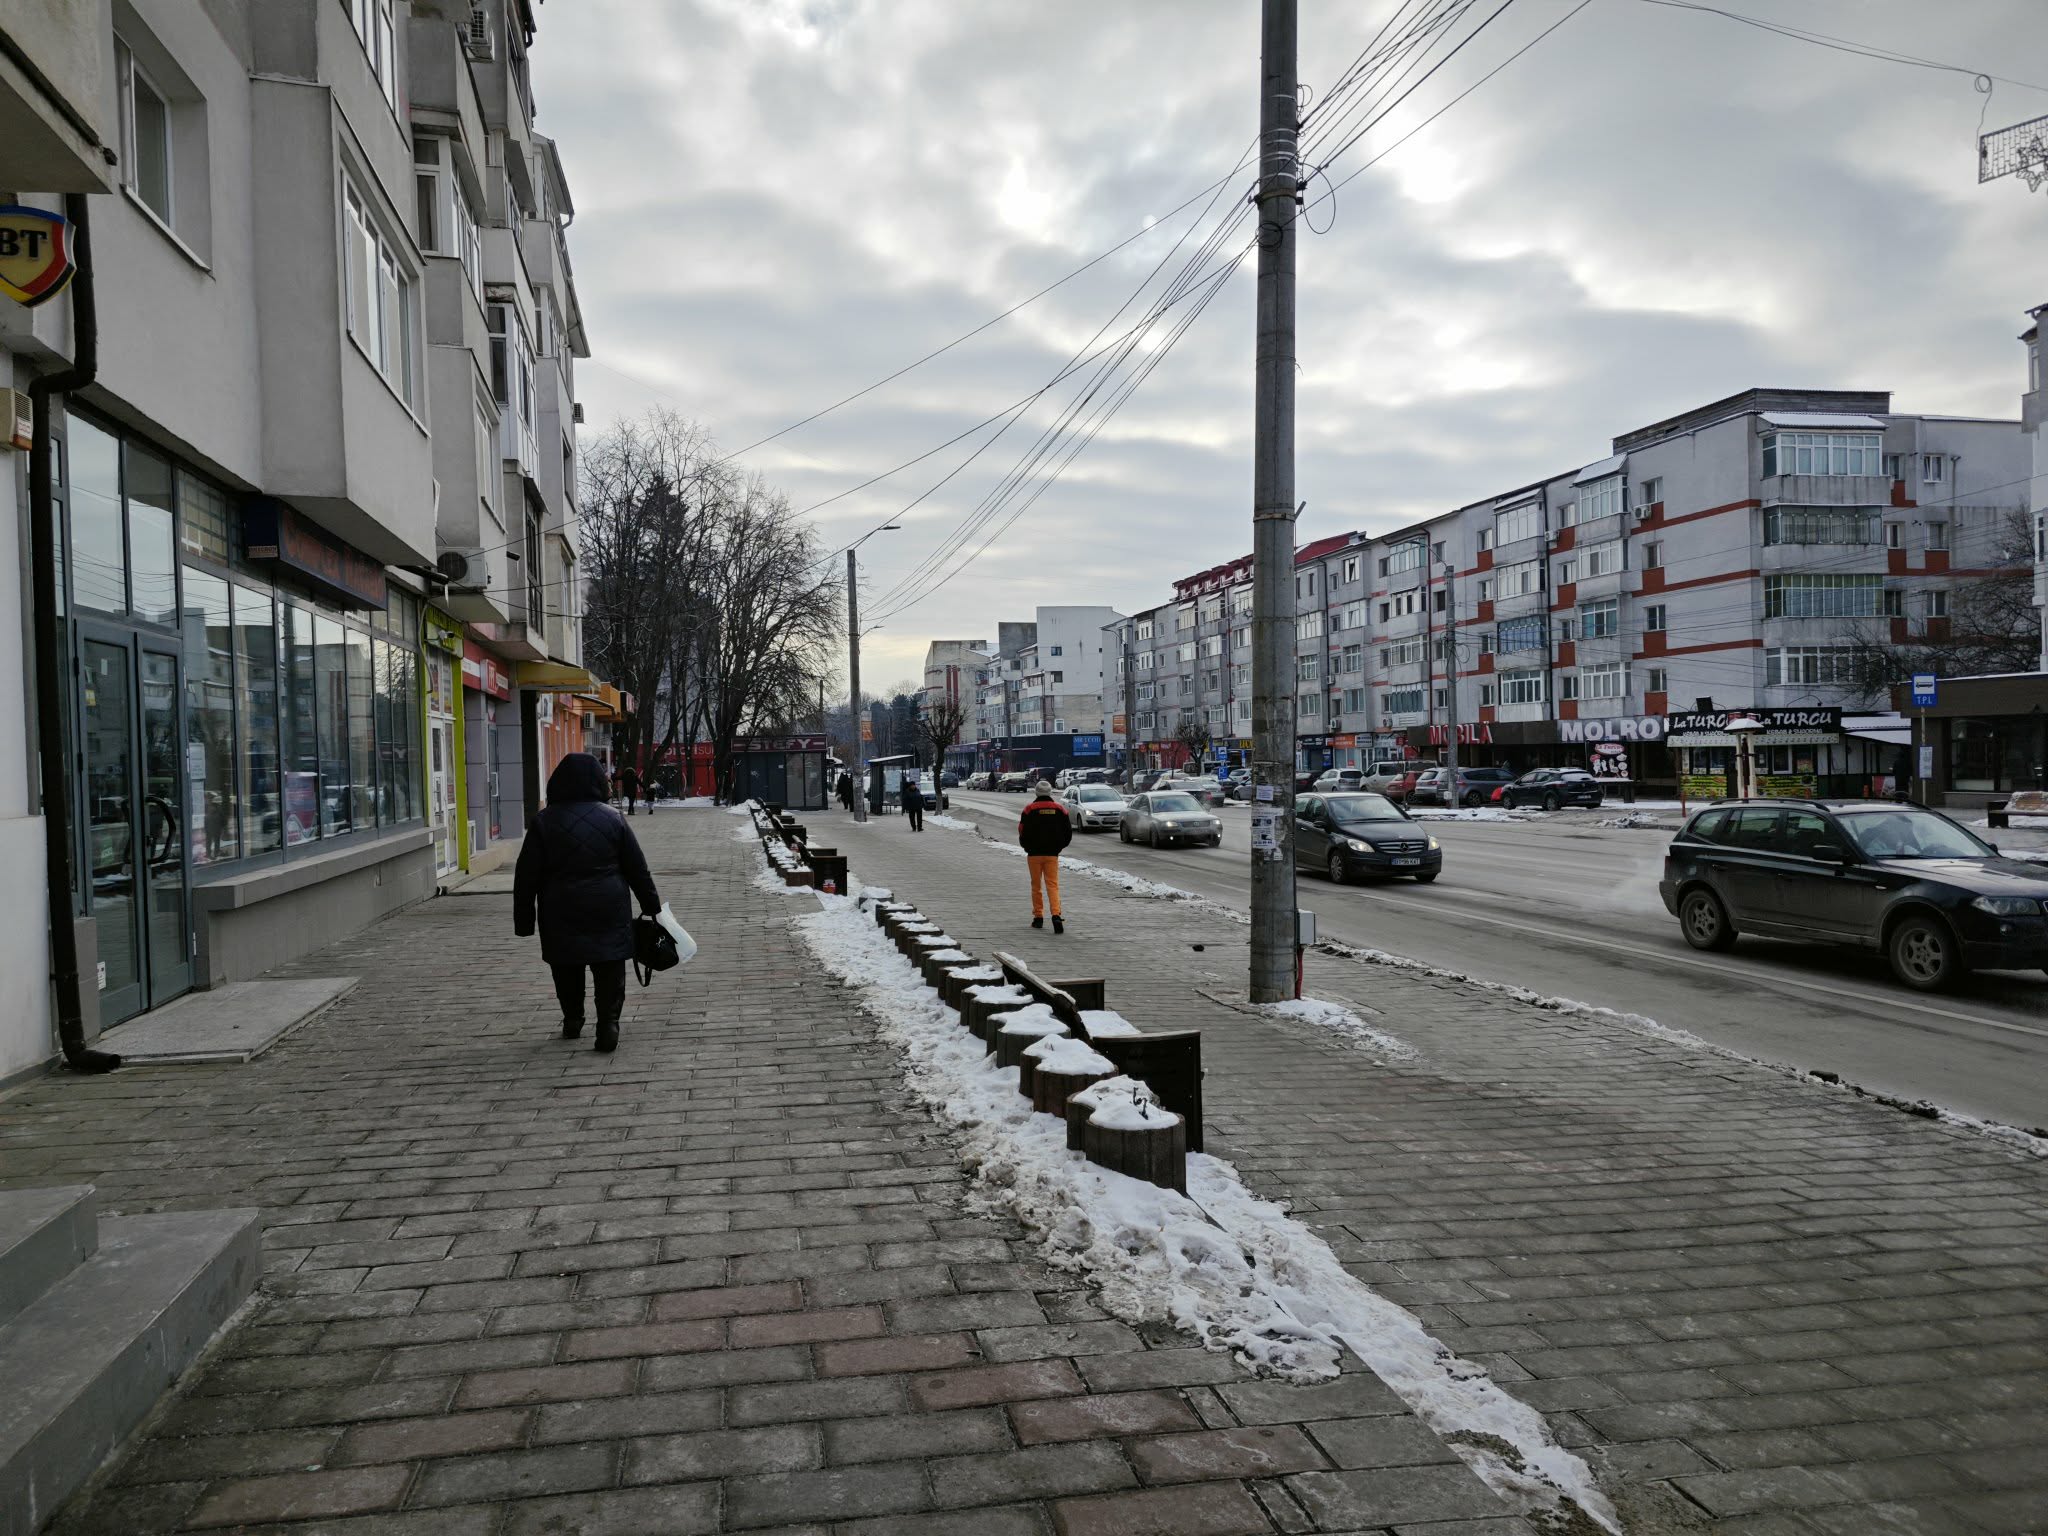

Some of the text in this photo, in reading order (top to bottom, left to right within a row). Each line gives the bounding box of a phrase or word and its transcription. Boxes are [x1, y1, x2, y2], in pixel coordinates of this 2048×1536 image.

[0, 228, 47, 258] BT
[1686, 713, 1729, 729] TURC
[1772, 711, 1832, 726] TURCU
[1561, 718, 1660, 742] MOLRO
